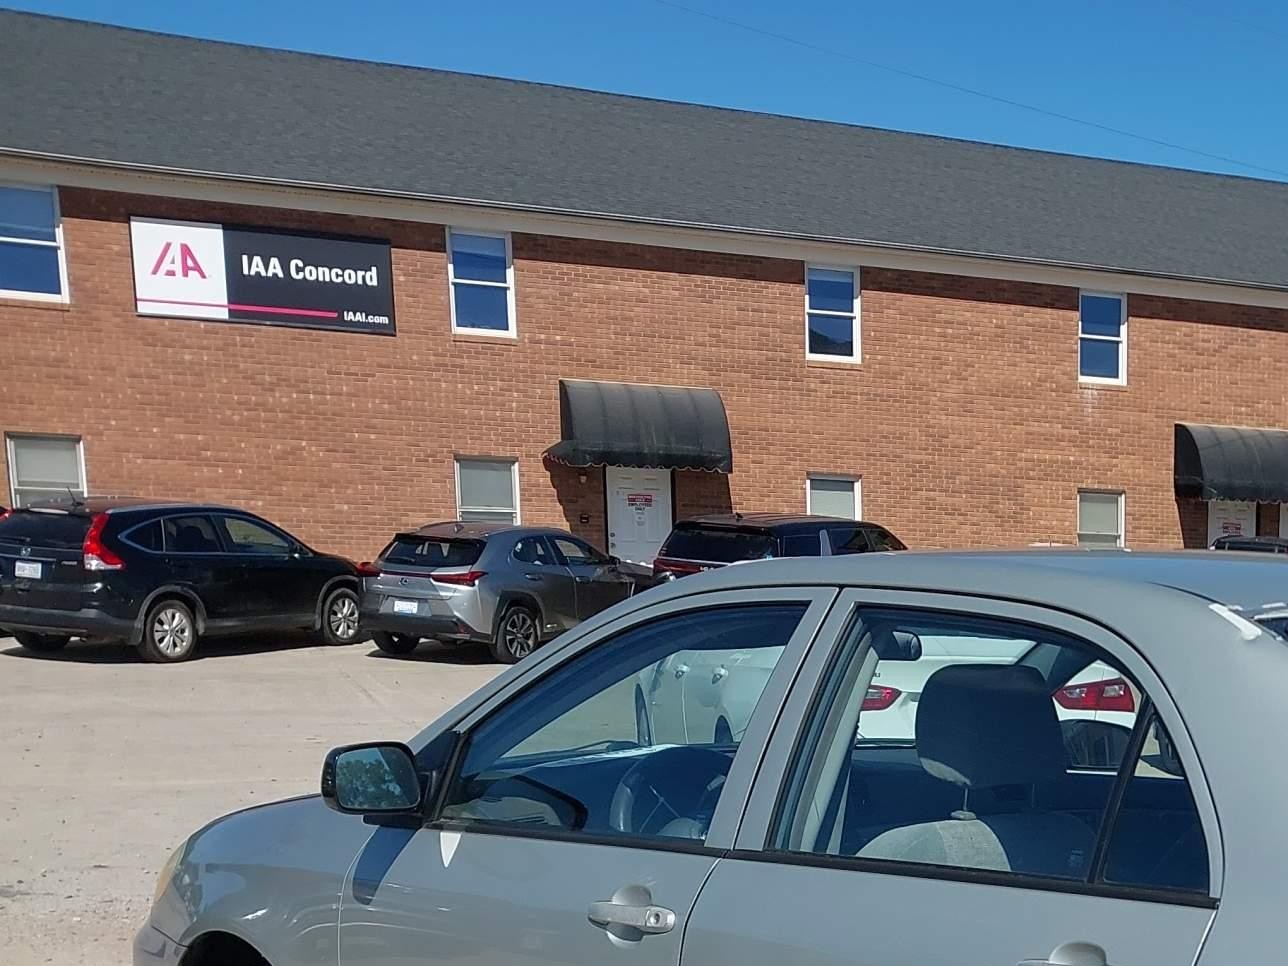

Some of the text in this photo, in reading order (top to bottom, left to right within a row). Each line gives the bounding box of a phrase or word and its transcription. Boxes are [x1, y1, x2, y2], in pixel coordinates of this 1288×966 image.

[242, 255, 378, 286] IAA Concord
[344, 311, 389, 324] IAAI.com
